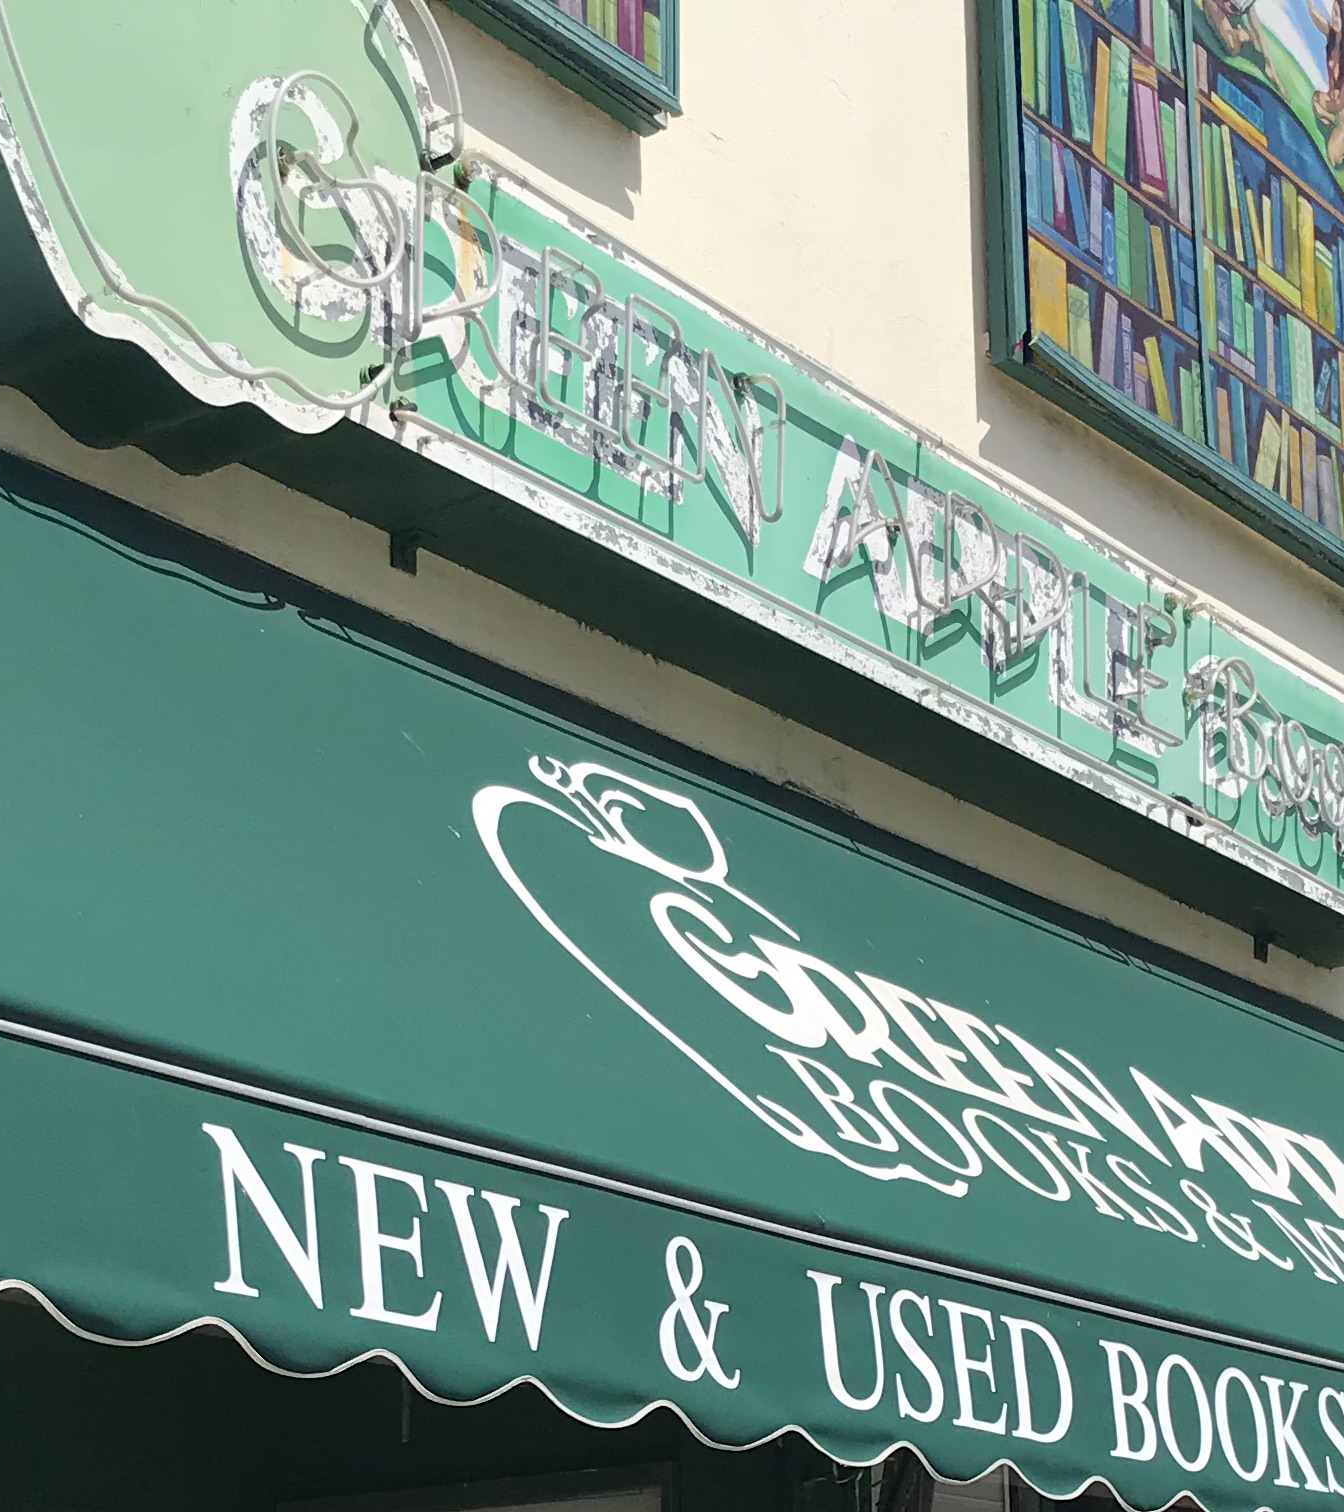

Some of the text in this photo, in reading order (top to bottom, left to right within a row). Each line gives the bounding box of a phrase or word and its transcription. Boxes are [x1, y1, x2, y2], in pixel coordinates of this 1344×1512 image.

[229, 70, 785, 546] GREEN
[803, 433, 1184, 758] APPLE
[651, 891, 1170, 1164] GREEN
[766, 1044, 1198, 1243] BOOKS
[1179, 1179, 1294, 1271] &
[201, 1122, 570, 1352] NEW
[658, 1235, 741, 1390] &
[806, 1269, 1074, 1445] USED
